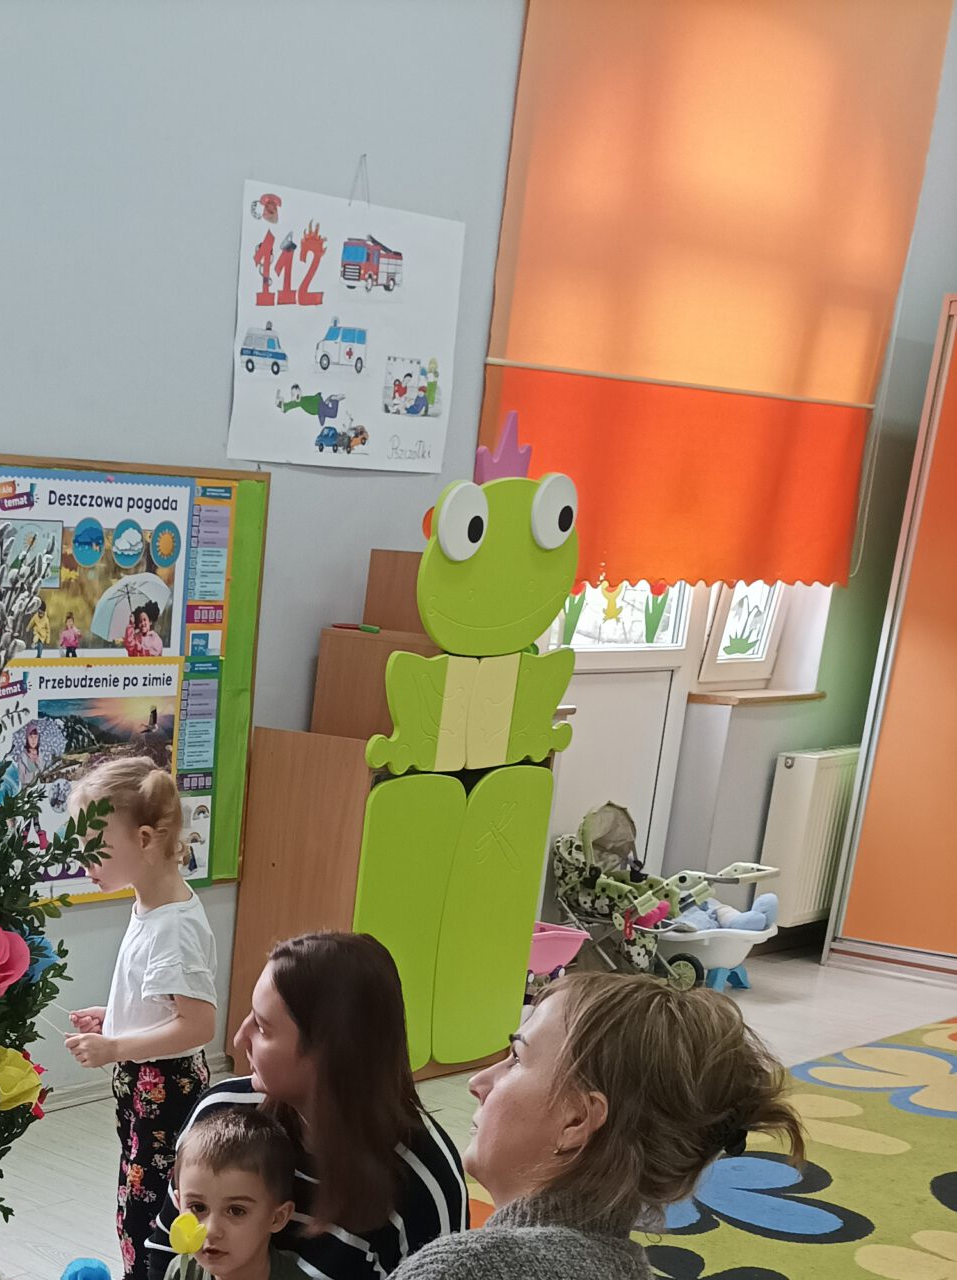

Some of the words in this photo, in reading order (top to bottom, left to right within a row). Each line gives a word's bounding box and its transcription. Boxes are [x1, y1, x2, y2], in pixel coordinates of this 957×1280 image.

[253, 222, 327, 306] 112
[48, 490, 123, 508] Deszczowa
[127, 496, 178, 513] pogoda
[39, 674, 119, 690] Przebudzenie
[123, 676, 138, 690] po
[142, 674, 173, 687] zimie
